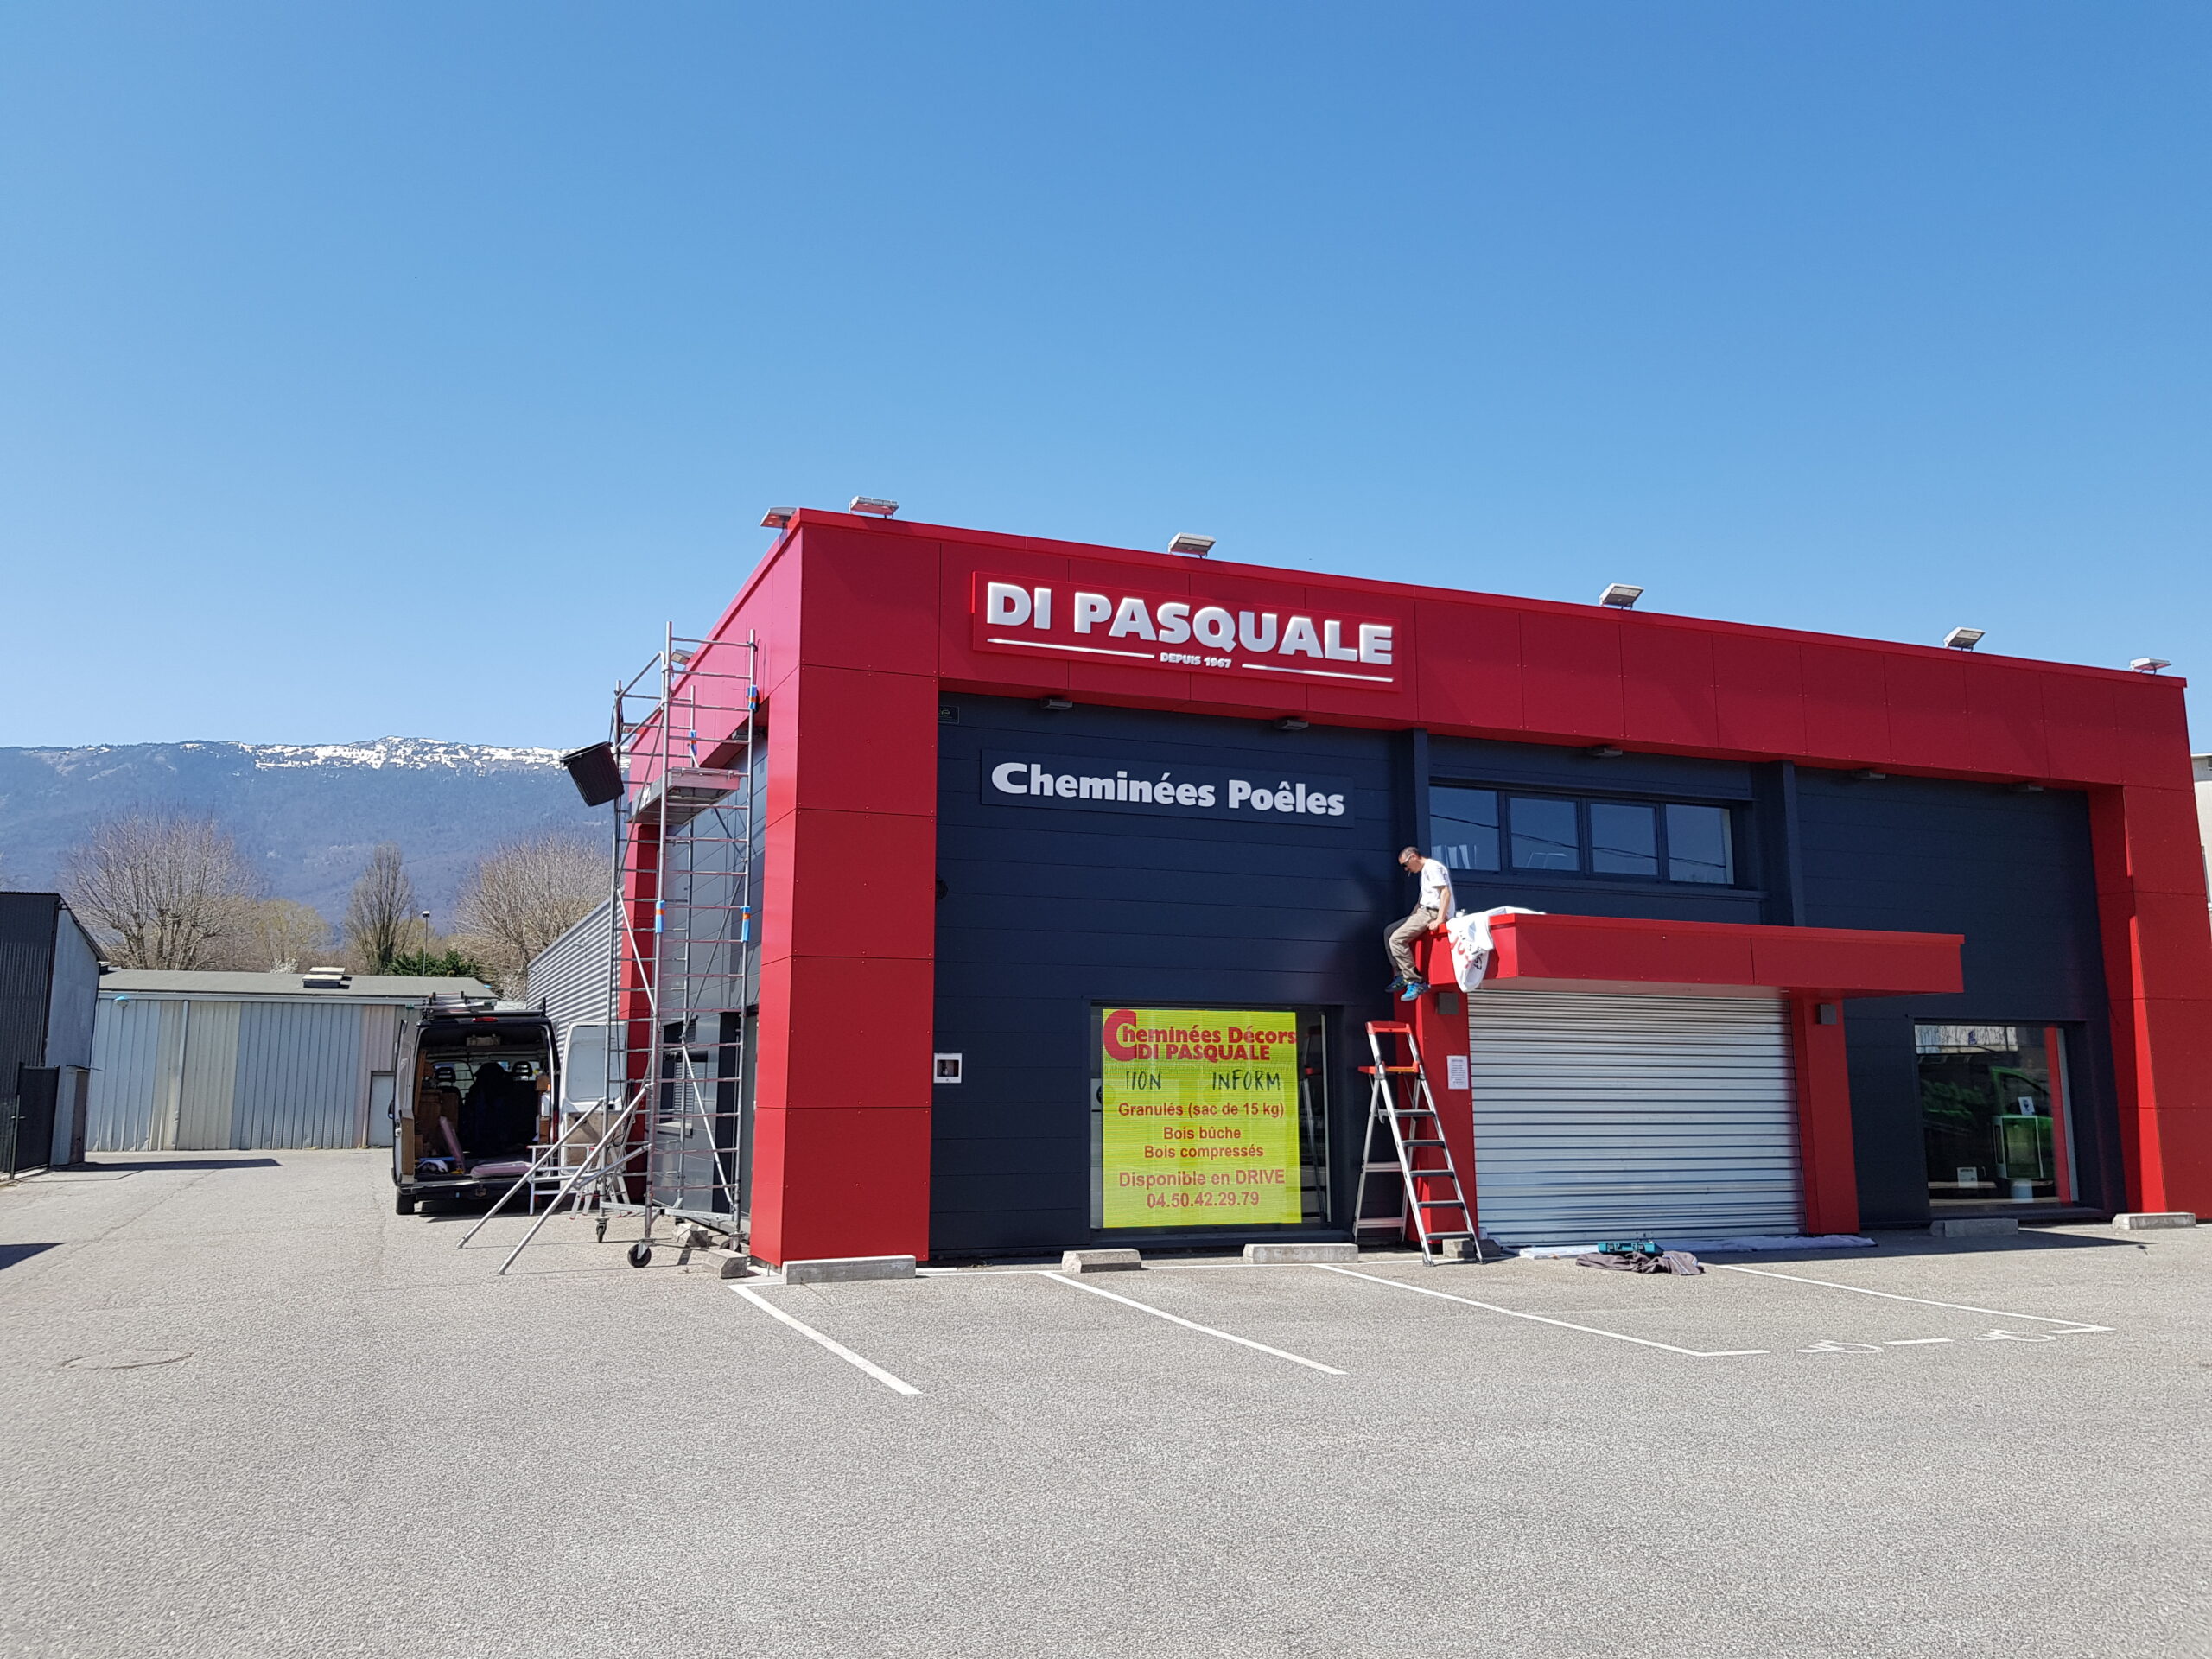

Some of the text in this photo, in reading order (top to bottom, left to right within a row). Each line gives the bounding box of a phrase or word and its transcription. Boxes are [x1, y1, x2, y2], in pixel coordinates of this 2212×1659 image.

[987, 582, 1393, 665] DI PASQUALE
[1160, 652, 1232, 669] DEPUIS 1967
[991, 762, 1345, 816] Cheminées Poêles
[1103, 1009, 1296, 1061] Cheminées Décors
[1136, 1044, 1270, 1063] DI PASQUALE
[1212, 1069, 1281, 1091] INFORM
[1118, 1102, 1284, 1118] Granulés (sac de 15 kg)
[1163, 1126, 1242, 1140] Bois bûche
[1144, 1144, 1264, 1160] Bois compressés
[1119, 1169, 1286, 1190] Disponible en DRIVE
[1147, 1191, 1260, 1209] 04.50.42.29.79
